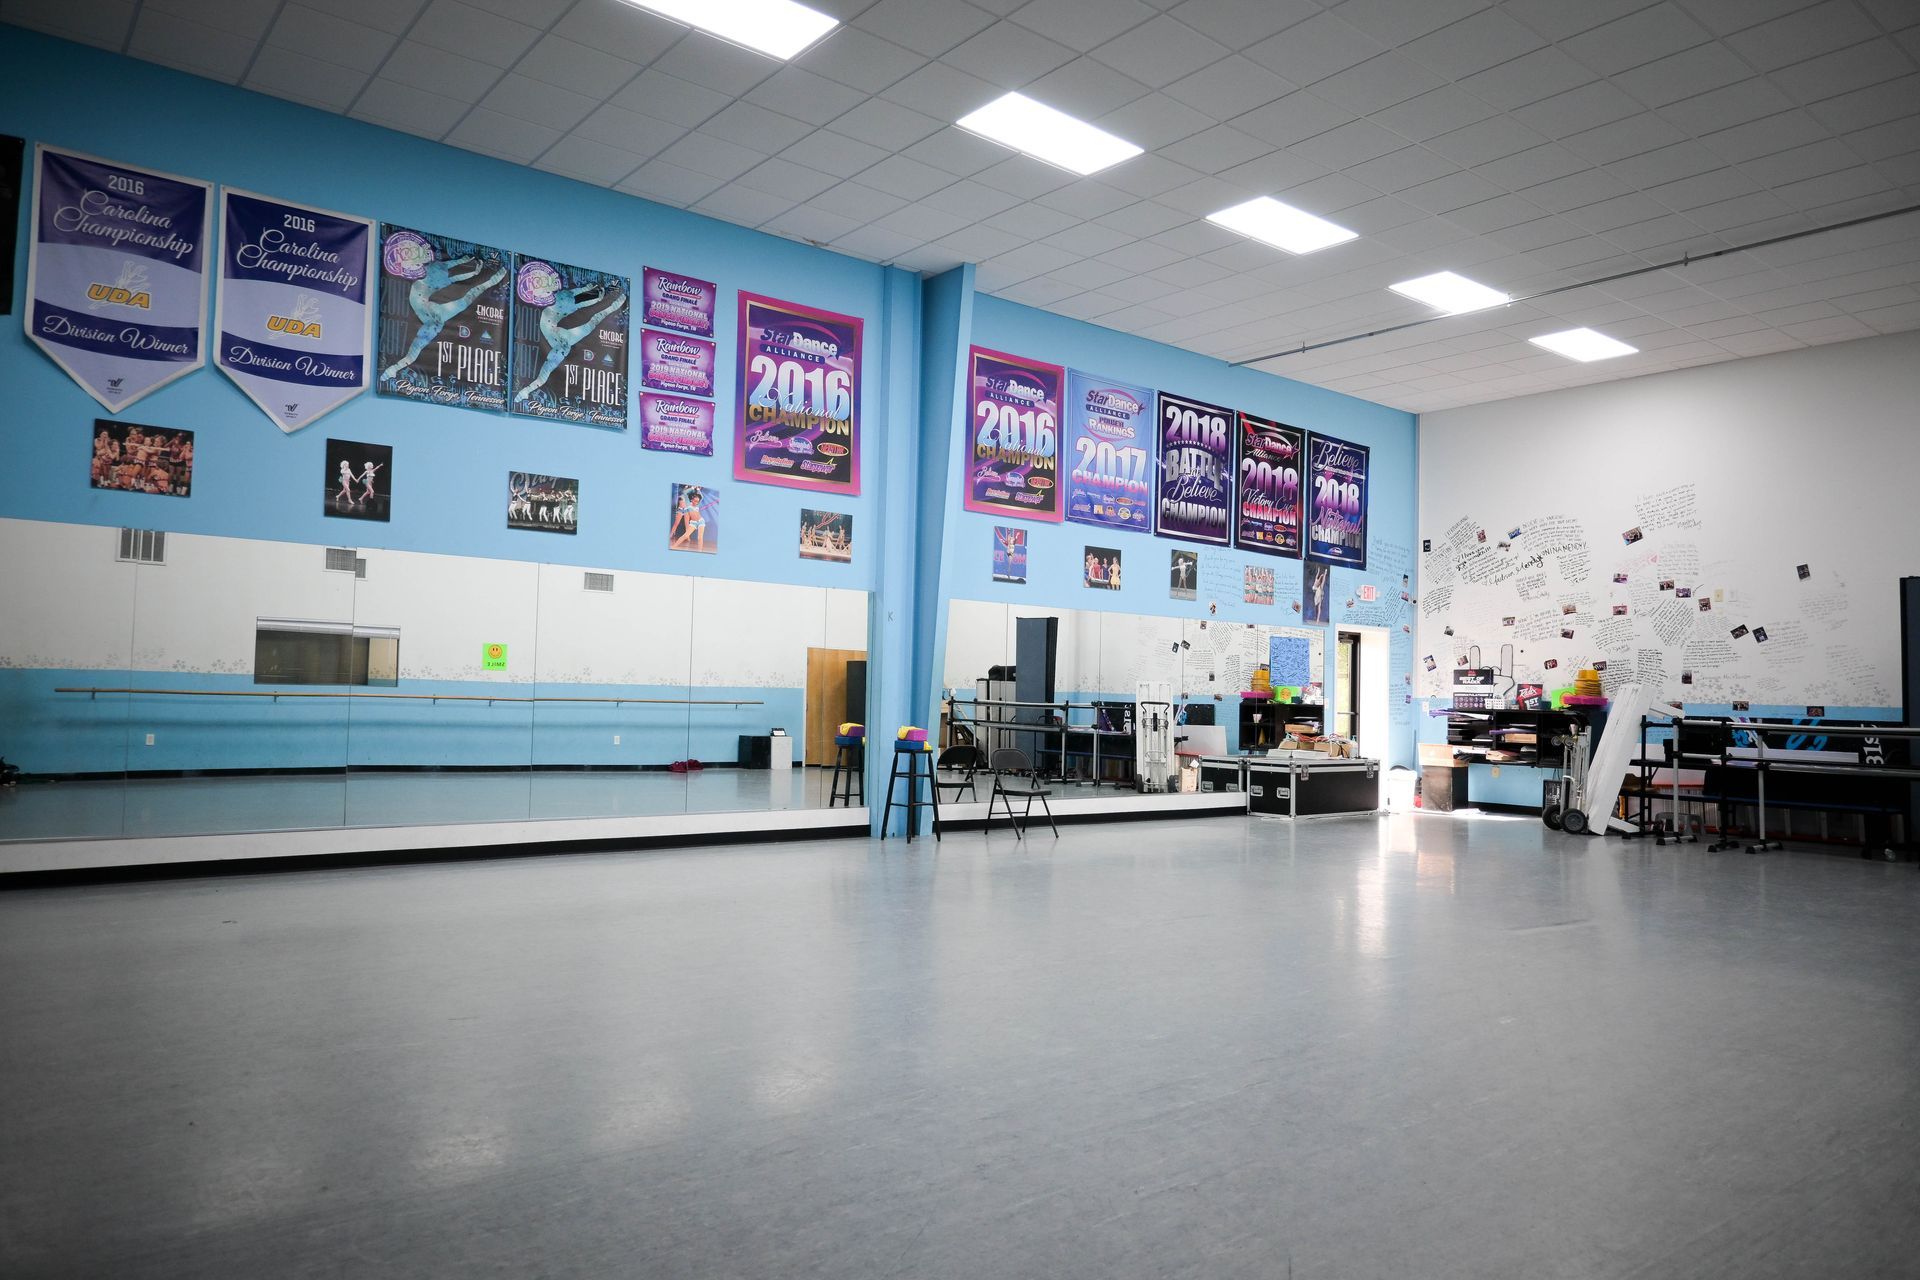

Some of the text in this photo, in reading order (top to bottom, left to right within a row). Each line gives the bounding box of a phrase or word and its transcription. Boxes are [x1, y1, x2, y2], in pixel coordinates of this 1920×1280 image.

[108, 174, 145, 196] 2016
[80, 188, 173, 230] Carolina
[53, 204, 193, 258] Championship
[284, 214, 315, 233] 2016
[259, 227, 340, 264] Carolina
[236, 242, 358, 293] Championship
[87, 283, 151, 309] UDA
[659, 276, 702, 295] Rainbow
[476, 304, 504, 320] ENCORE
[45, 315, 190, 355] Division Winner
[266, 315, 321, 339] UDA
[599, 329, 624, 343] ENCORE
[657, 338, 700, 354] Rainbow
[761, 327, 838, 356] StarDance
[766, 346, 820, 362] ALLIANCE
[229, 346, 356, 382] Division Winner
[437, 341, 501, 386] 1ST PLACE
[396, 379, 505, 404] Pigeon Forge, Tennessee
[565, 364, 579, 397] 1ST
[583, 367, 622, 406] PLACE
[749, 355, 850, 420] 2016
[986, 376, 1044, 401] StarDance
[528, 401, 624, 423] Pigeon Forge, Tennessee
[656, 399, 699, 414] Rainbow
[990, 393, 1030, 406] ALLIANCE
[1087, 390, 1139, 413] StarDance
[1090, 405, 1126, 418] ALLIANCE
[749, 404, 849, 435] CHAMPION
[977, 400, 1054, 457] 2016
[1089, 419, 1134, 438] RANKINGS
[1166, 405, 1226, 452] 2018
[1245, 432, 1292, 454] StarDance
[977, 444, 1054, 470] CHAMPION
[1076, 436, 1147, 481] 2017
[1166, 447, 1224, 492] BATTLE
[1312, 441, 1362, 472] Believe
[1072, 470, 1147, 496] CHAMPION
[1167, 473, 1222, 503] Believe
[1242, 457, 1298, 500] 2018
[1243, 488, 1274, 514] Victory
[1315, 476, 1359, 515] 2018
[1162, 497, 1226, 527] CHAMPION
[1243, 501, 1296, 526] CHAMPION
[1312, 525, 1361, 548] CHAMPION
